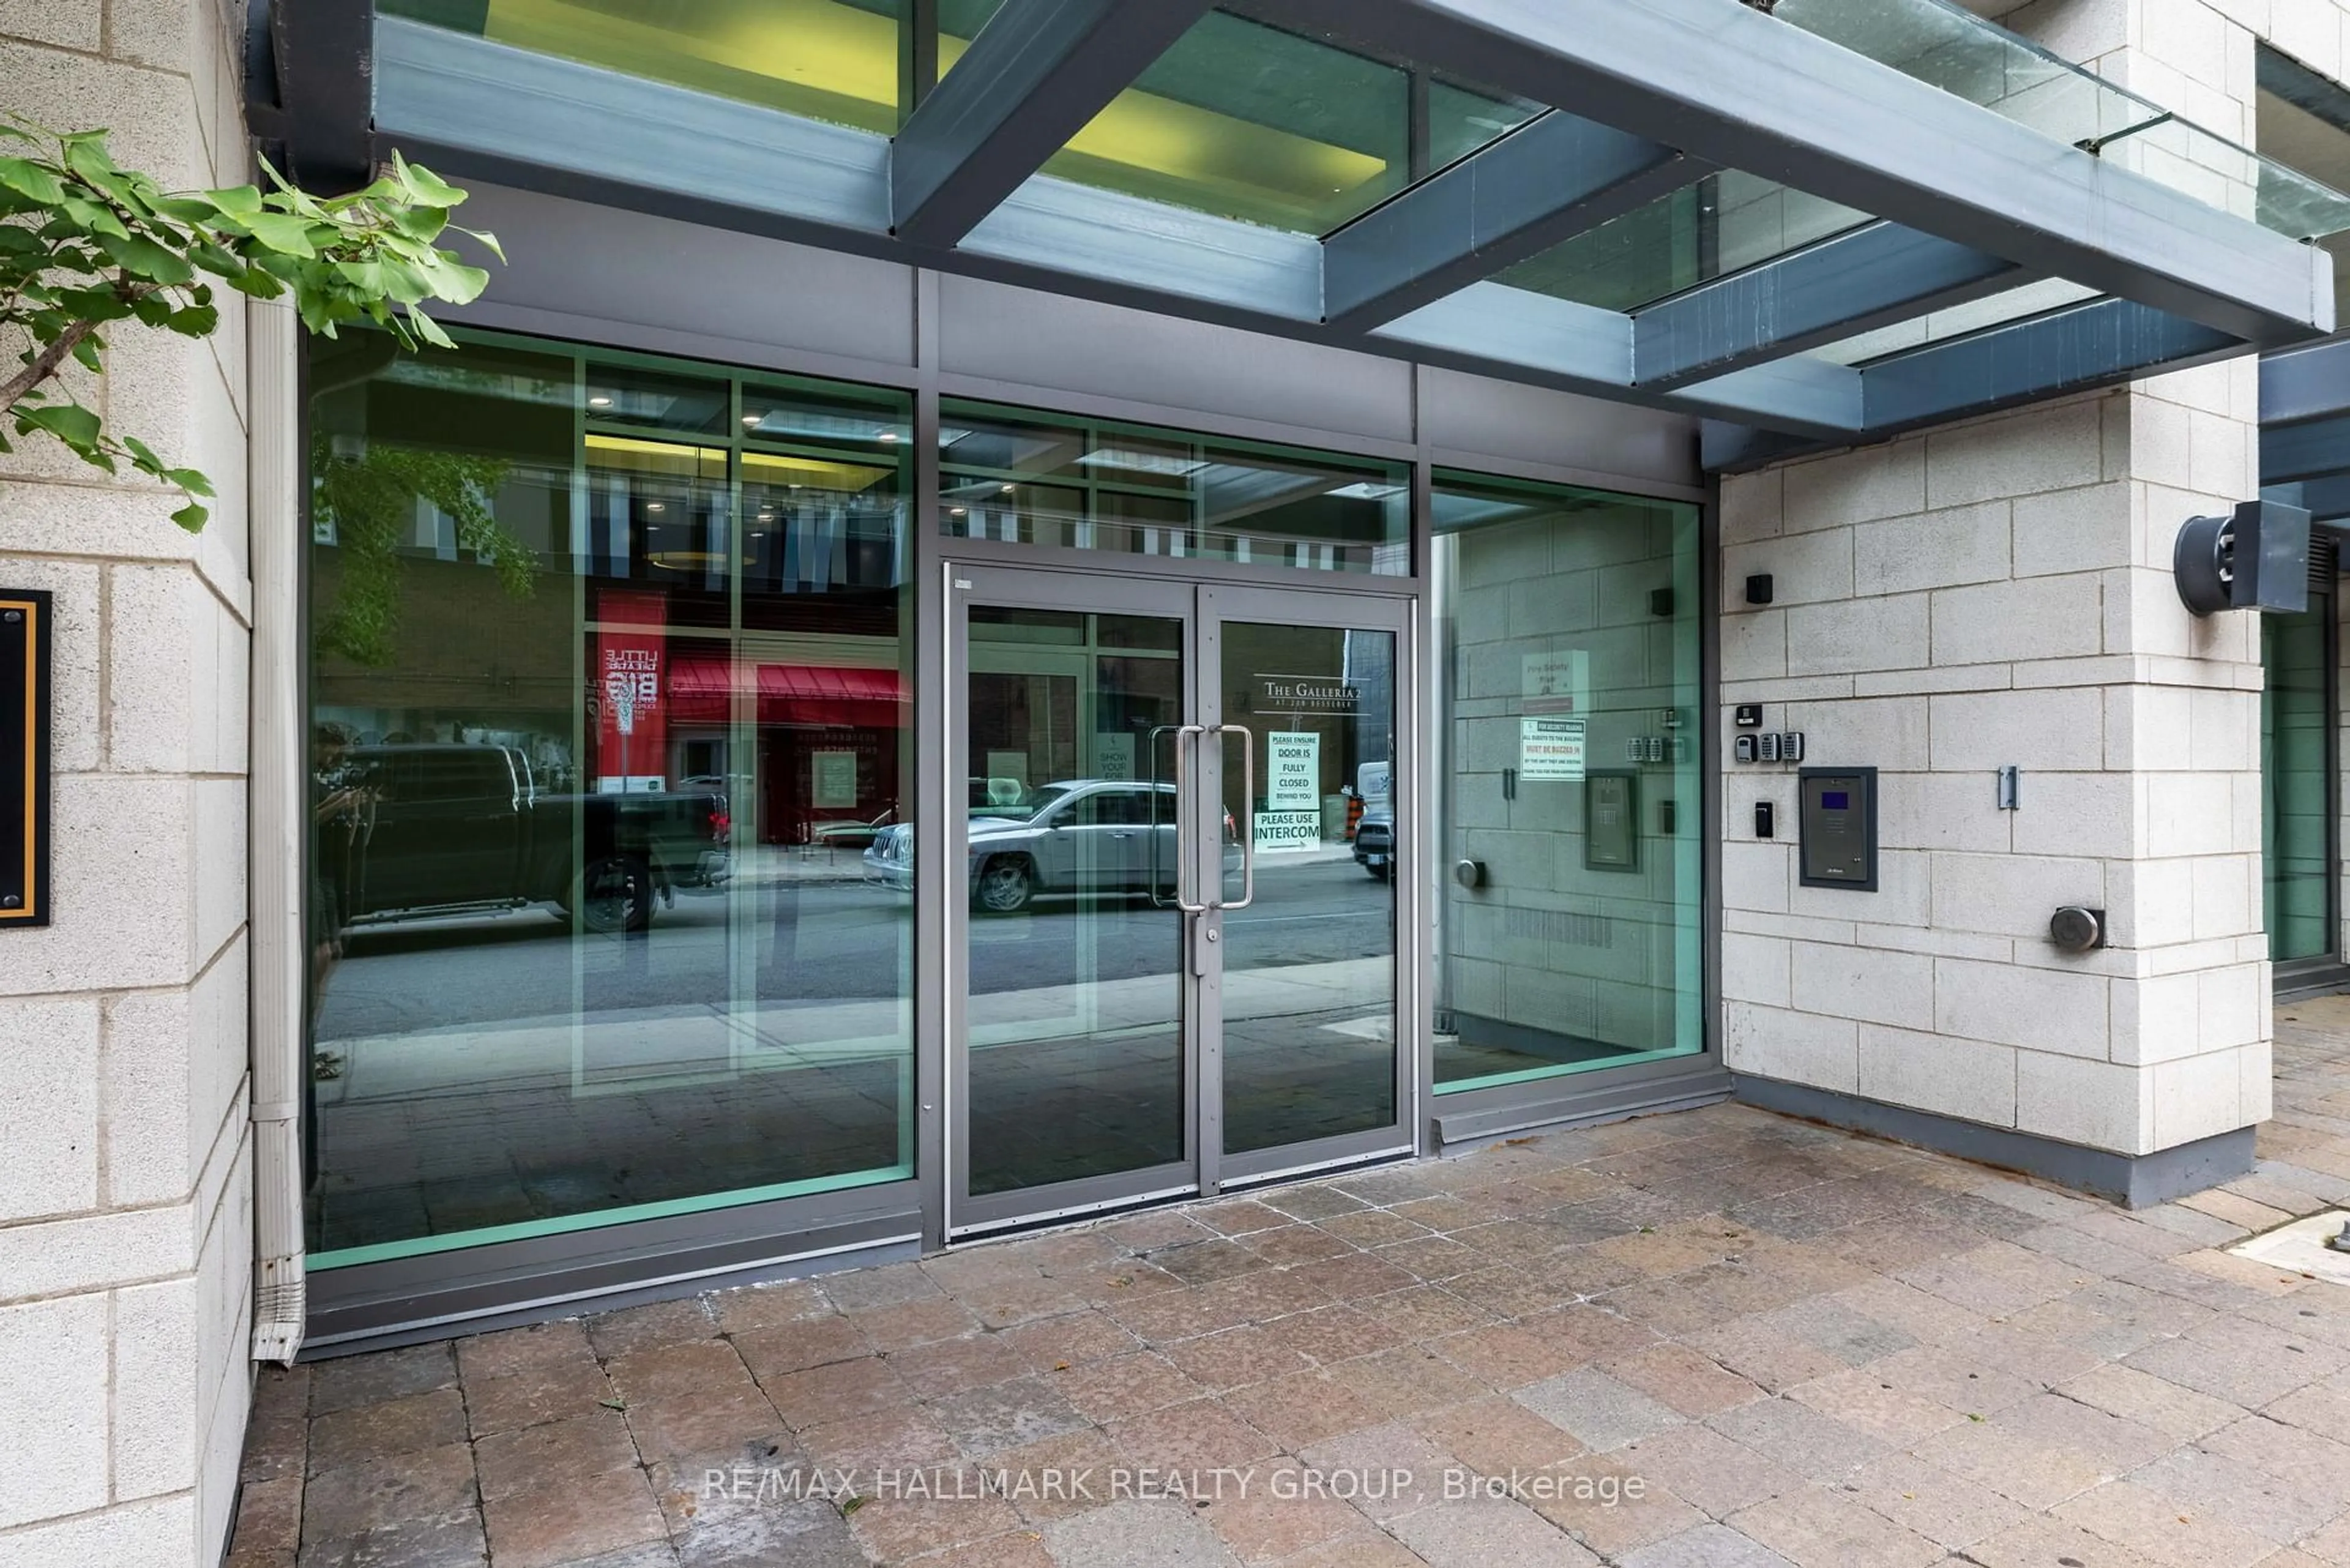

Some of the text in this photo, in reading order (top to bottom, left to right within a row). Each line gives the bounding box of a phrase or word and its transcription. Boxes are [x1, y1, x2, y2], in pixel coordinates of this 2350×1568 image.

[1100, 753, 1127, 761] SHOW
[1304, 749, 1310, 758] IS
[1279, 778, 1309, 787] CLOSED
[1261, 814, 1313, 824] PLEASE USE
[1255, 826, 1319, 840] INTERCOM
